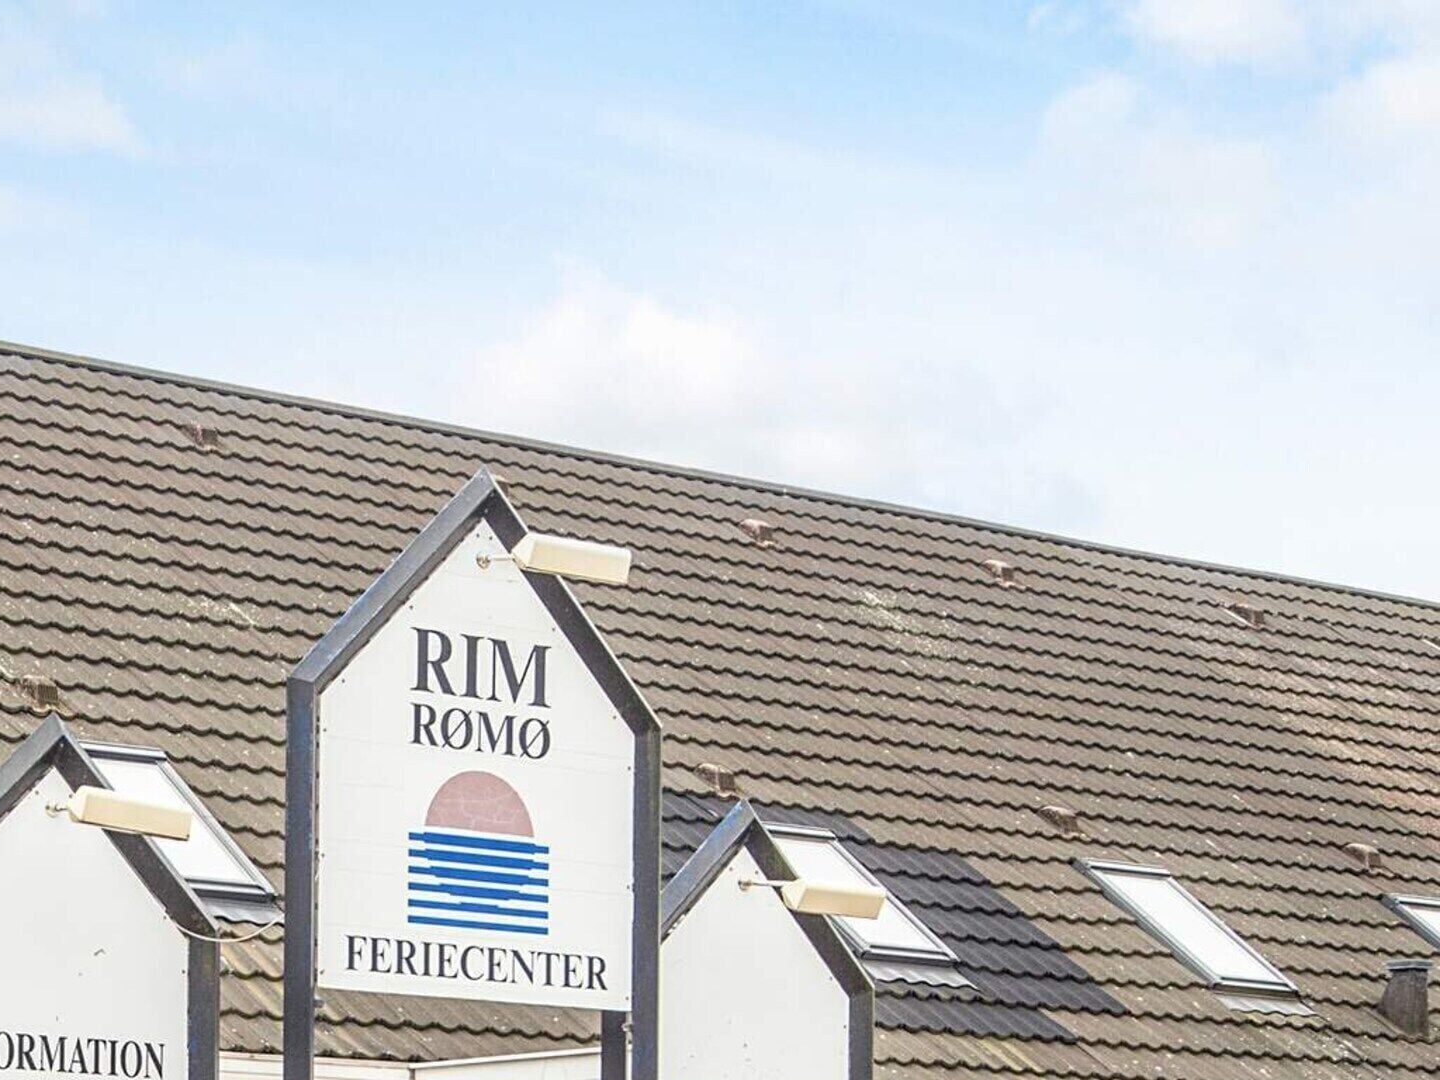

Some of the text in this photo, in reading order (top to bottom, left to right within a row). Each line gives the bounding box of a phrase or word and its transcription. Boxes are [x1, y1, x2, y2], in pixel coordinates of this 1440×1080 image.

[411, 626, 552, 709] RIM
[411, 702, 552, 761] RØMØ
[345, 935, 609, 992] FERIECENTER
